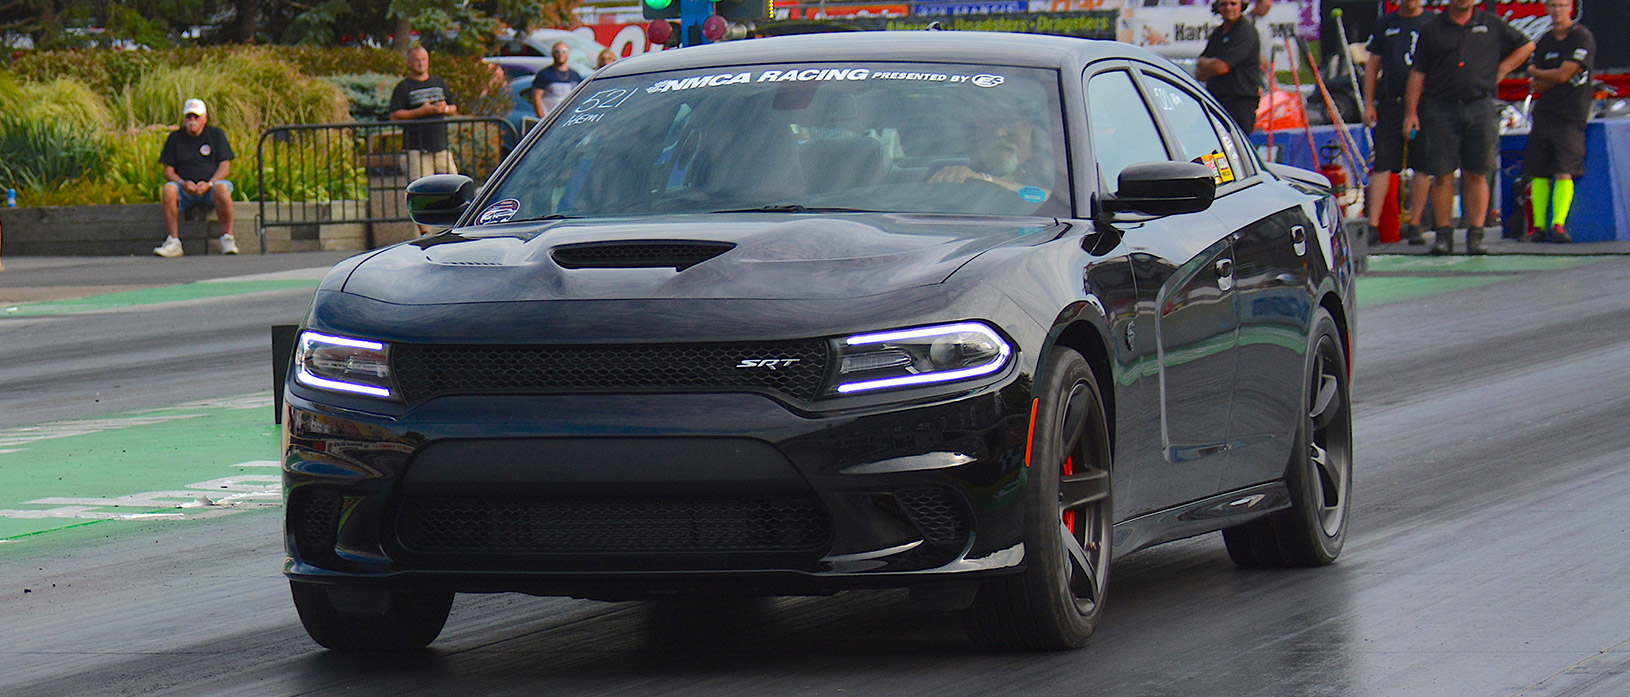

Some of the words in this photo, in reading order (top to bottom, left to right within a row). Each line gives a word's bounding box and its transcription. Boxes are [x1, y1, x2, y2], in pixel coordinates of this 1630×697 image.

[1037, 15, 1110, 33] Dragsters
[659, 72, 752, 93] NMCA
[757, 68, 871, 83] RACING
[872, 71, 947, 82] PRESENTED
[949, 74, 970, 83] BY
[575, 87, 639, 113] 521
[562, 112, 605, 128] HEMI
[735, 358, 801, 371] SRT
